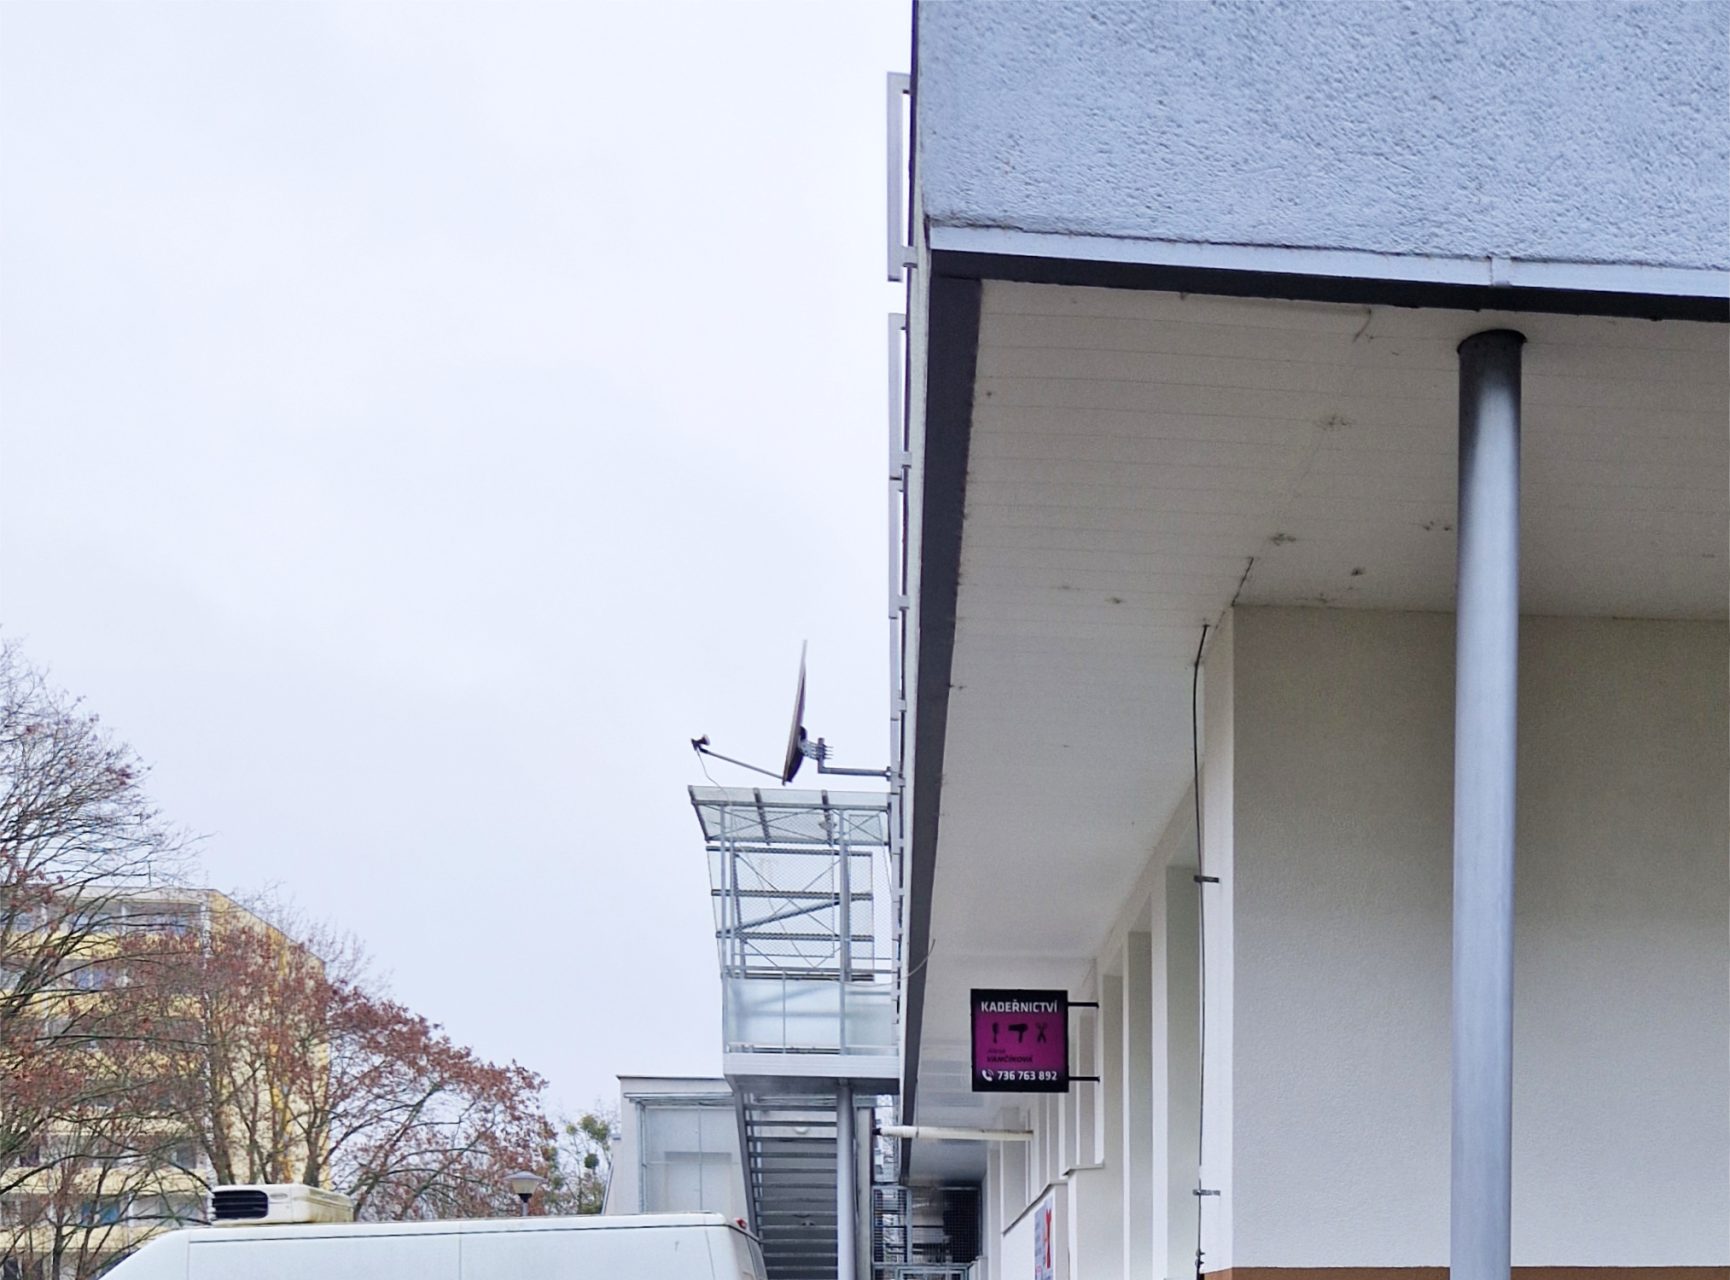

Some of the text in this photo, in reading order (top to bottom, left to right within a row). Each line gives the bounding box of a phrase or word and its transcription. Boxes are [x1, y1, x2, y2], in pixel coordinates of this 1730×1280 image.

[981, 999, 1058, 1013] KADEŘNICTVÍ
[997, 1070, 1058, 1081] 736 763 892
